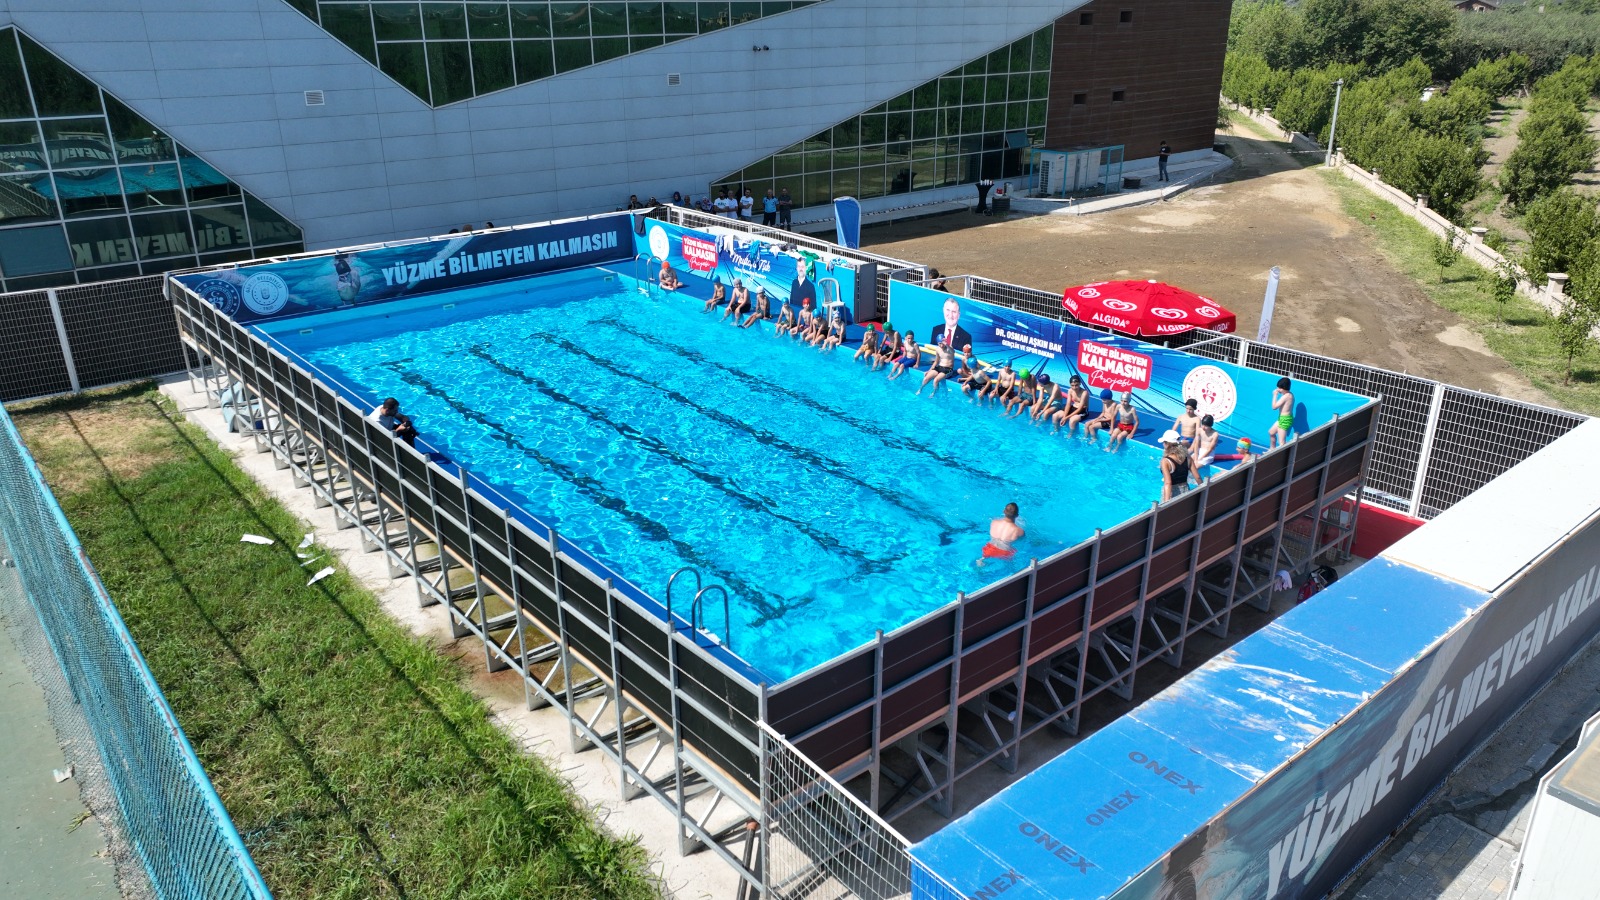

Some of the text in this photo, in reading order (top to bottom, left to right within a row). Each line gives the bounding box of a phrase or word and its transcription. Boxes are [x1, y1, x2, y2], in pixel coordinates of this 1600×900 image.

[381, 230, 618, 286] YÜZME BİLMEYEN KALMASIN
[684, 245, 716, 263] KALMASIN
[995, 328, 1063, 353] DR. OSMAN AŞKIN BAK
[1082, 342, 1148, 368] YÜZME BİLMEYEN
[1080, 352, 1147, 382] KALMASIN
[1091, 369, 1133, 390] Projesi
[1266, 742, 1402, 900] YÜZME
[1400, 603, 1554, 780] BİLMEYEN
[1128, 751, 1204, 796] ONEX
[1085, 789, 1141, 827] ONEX
[1018, 821, 1097, 875] ONEX
